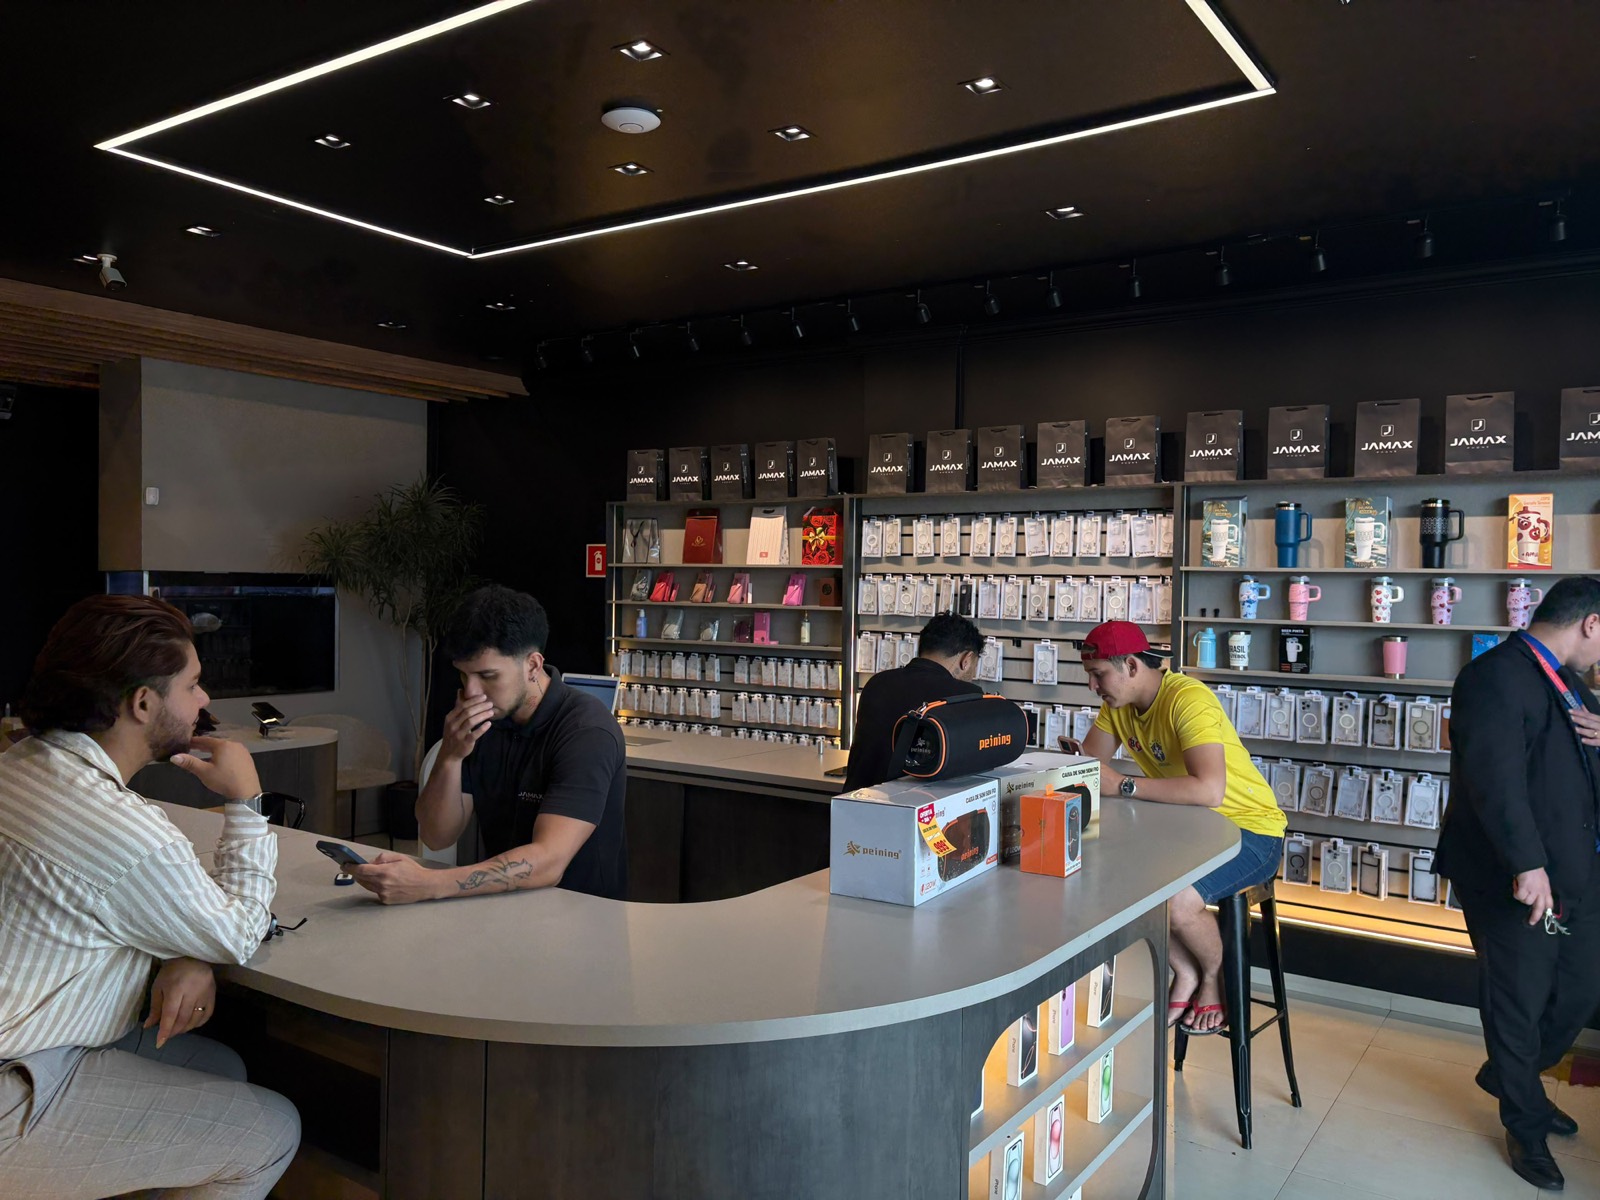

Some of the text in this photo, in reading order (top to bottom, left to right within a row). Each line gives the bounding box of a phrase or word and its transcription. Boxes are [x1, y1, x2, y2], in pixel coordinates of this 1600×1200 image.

[1450, 435, 1507, 447] JAMAX
[1566, 431, 1600, 441] JAM
[1272, 444, 1320, 455] JAMAX
[1360, 440, 1413, 451] JAMAX
[1109, 452, 1151, 462] JAMAX
[1189, 448, 1233, 458] JAMAX
[981, 460, 1017, 469] JAMAX
[1041, 456, 1081, 466] JAMAX
[870, 465, 904, 473] JAMAX
[929, 463, 964, 472] JAMAX
[714, 474, 740, 482] JAMAX
[758, 472, 785, 480] JAMAX
[800, 469, 826, 478] JAMAX
[979, 733, 1011, 750] peining
[862, 847, 899, 860] peining
